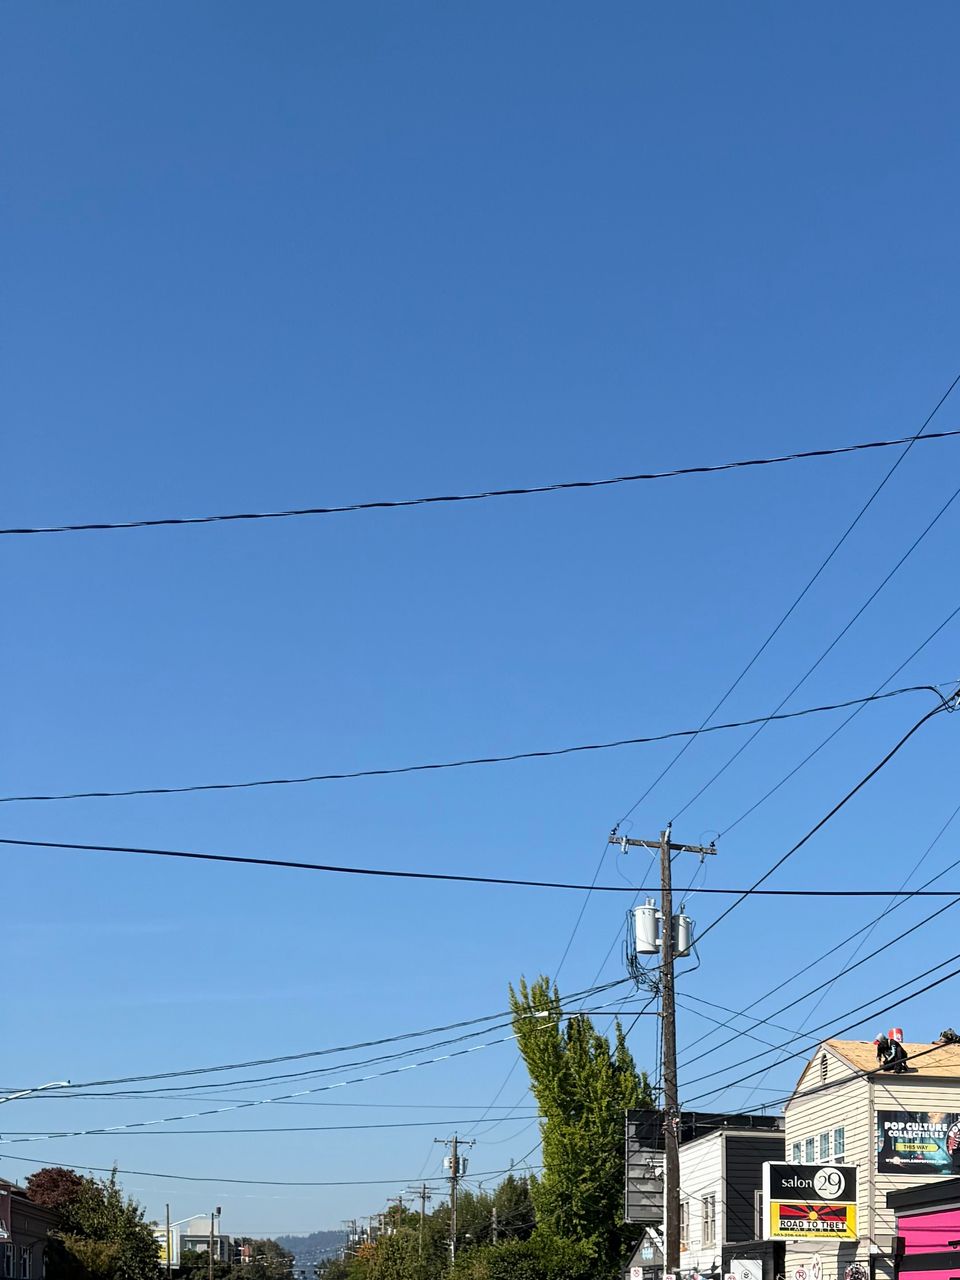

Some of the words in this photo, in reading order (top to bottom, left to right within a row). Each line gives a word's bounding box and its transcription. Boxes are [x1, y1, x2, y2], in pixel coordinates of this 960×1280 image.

[884, 1121, 904, 1130] POP
[905, 1122, 948, 1132] CULTURE
[888, 1130, 944, 1139] COLLECTIBLES
[781, 1175, 813, 1188] salon
[818, 1172, 842, 1195] 29
[780, 1220, 804, 1228] ROAD
[821, 1221, 845, 1229] TIBET
